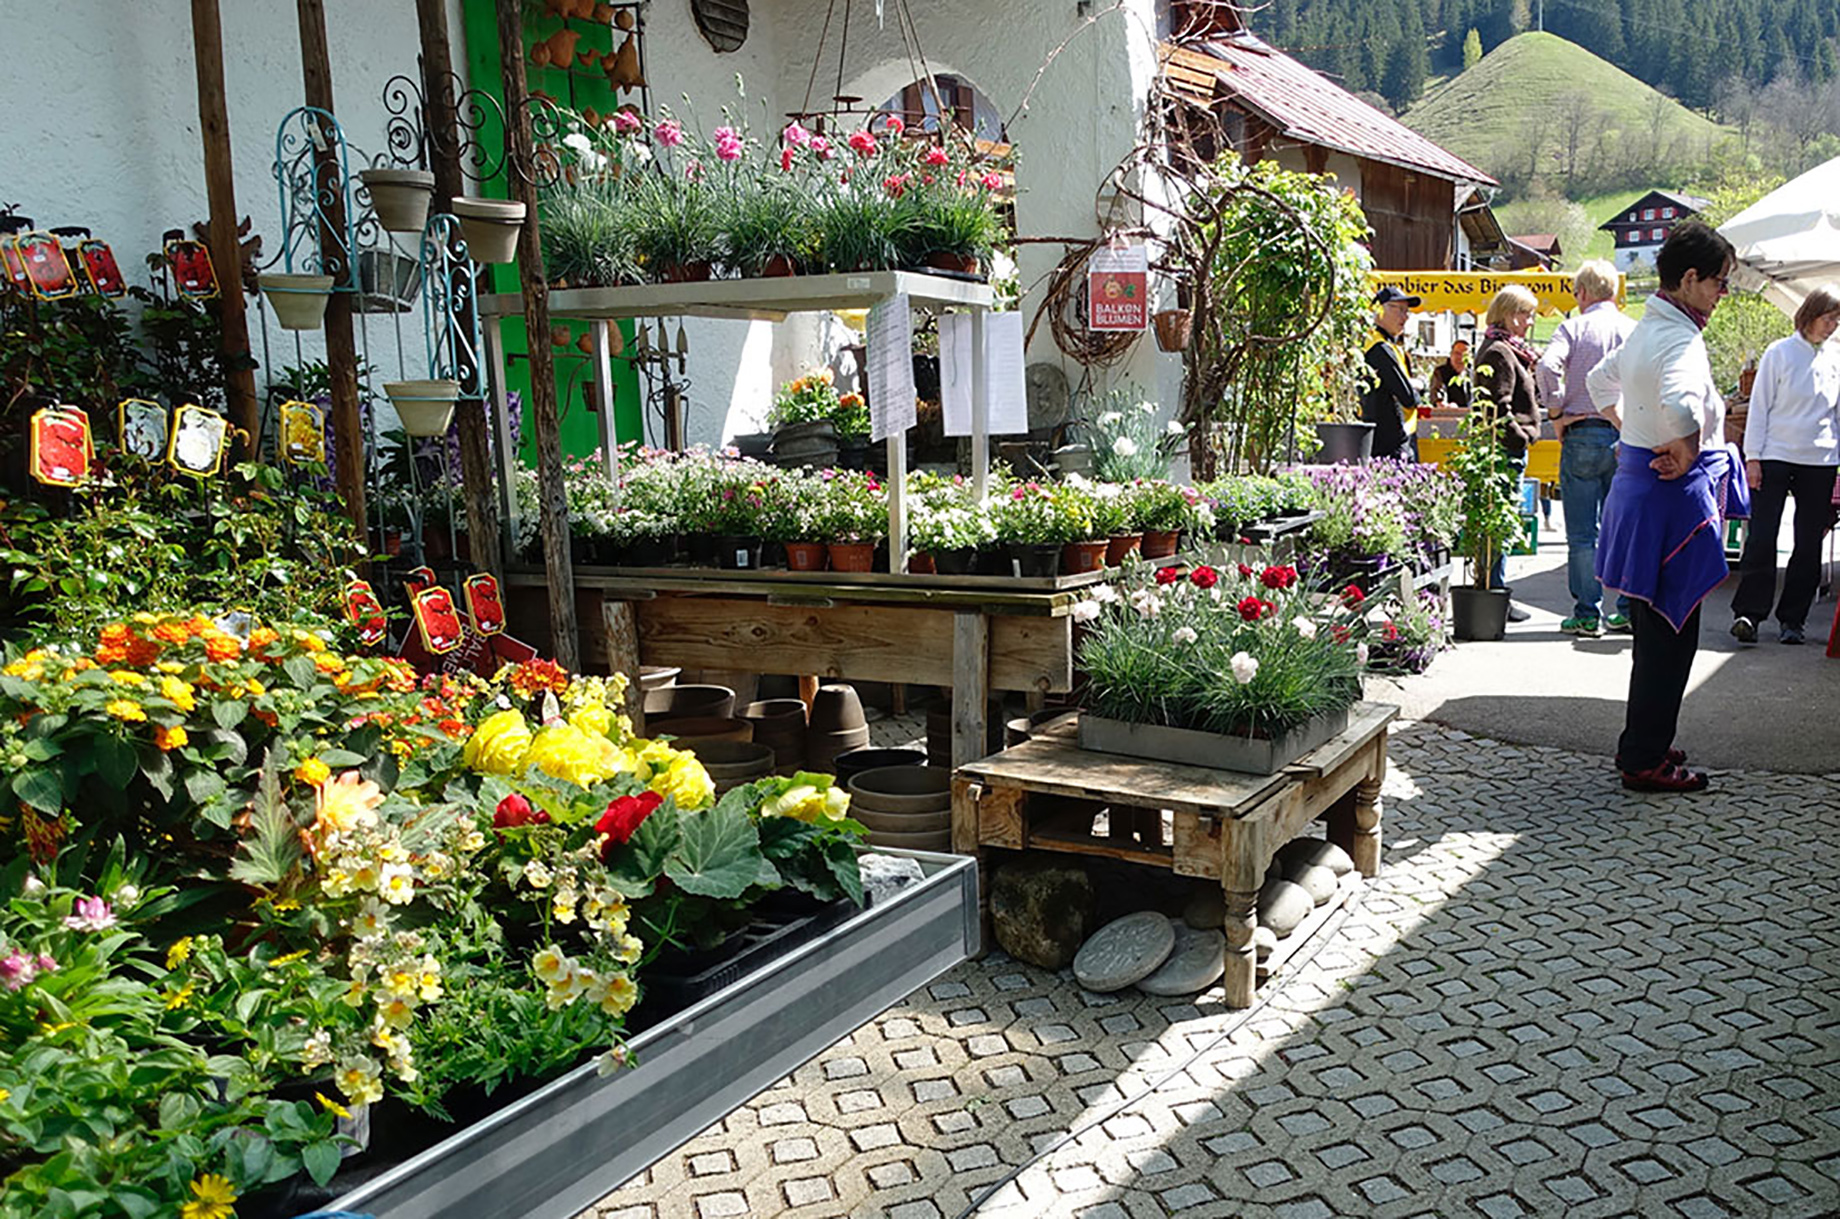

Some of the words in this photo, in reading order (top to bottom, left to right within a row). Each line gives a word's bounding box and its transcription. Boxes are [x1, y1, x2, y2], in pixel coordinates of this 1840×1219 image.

[1443, 280, 1474, 294] das
[1480, 278, 1507, 295] Bie
[1095, 303, 1142, 314] BALKON
[1095, 314, 1142, 325] BLUMEN
